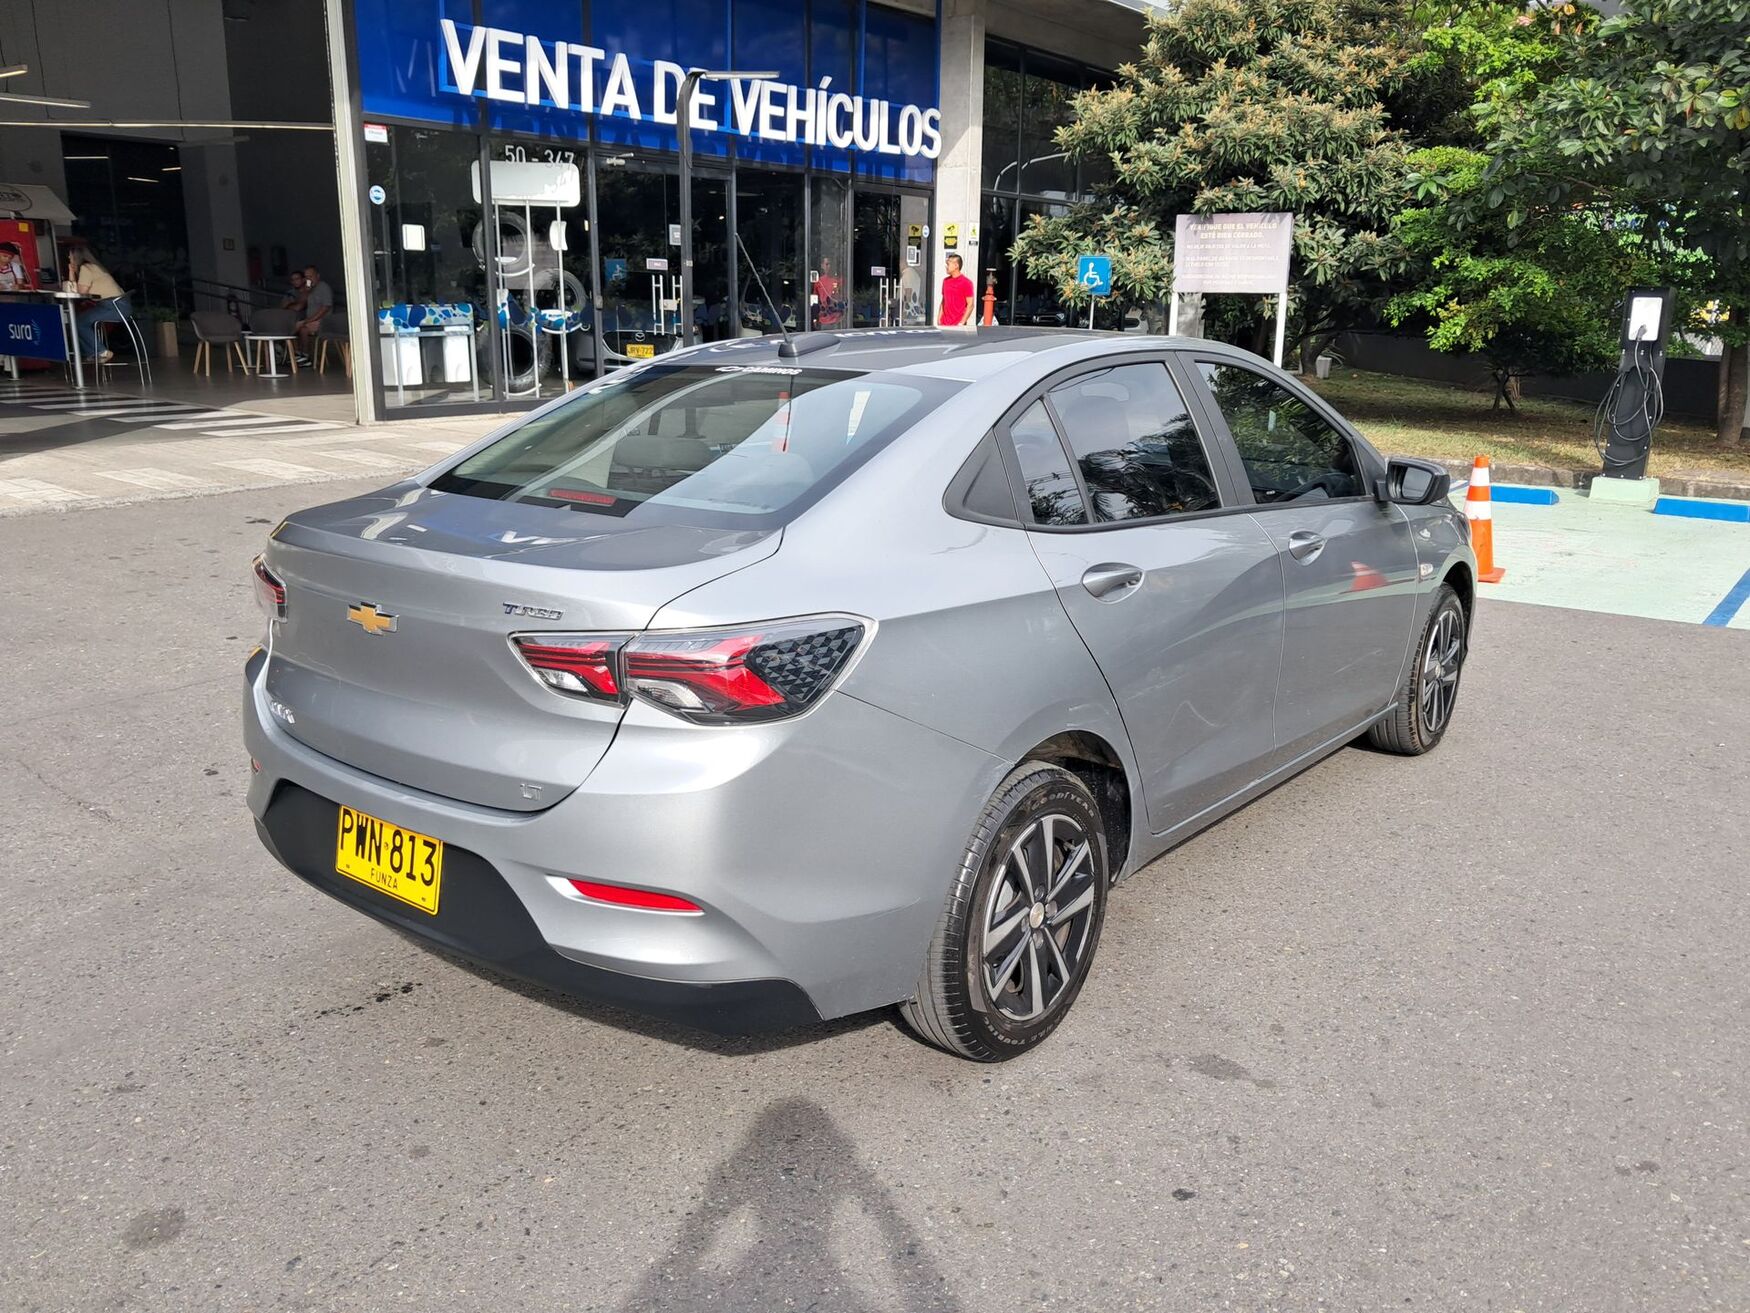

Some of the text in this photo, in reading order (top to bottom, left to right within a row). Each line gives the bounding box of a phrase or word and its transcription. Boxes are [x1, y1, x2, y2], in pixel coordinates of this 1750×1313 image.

[440, 19, 942, 159] VENTA DE VEHÍCULOS
[505, 145, 526, 164] 50
[544, 149, 575, 170] 347
[8, 323, 33, 340] sura
[340, 808, 437, 887] PWN 813
[370, 868, 399, 890] FUNZA
